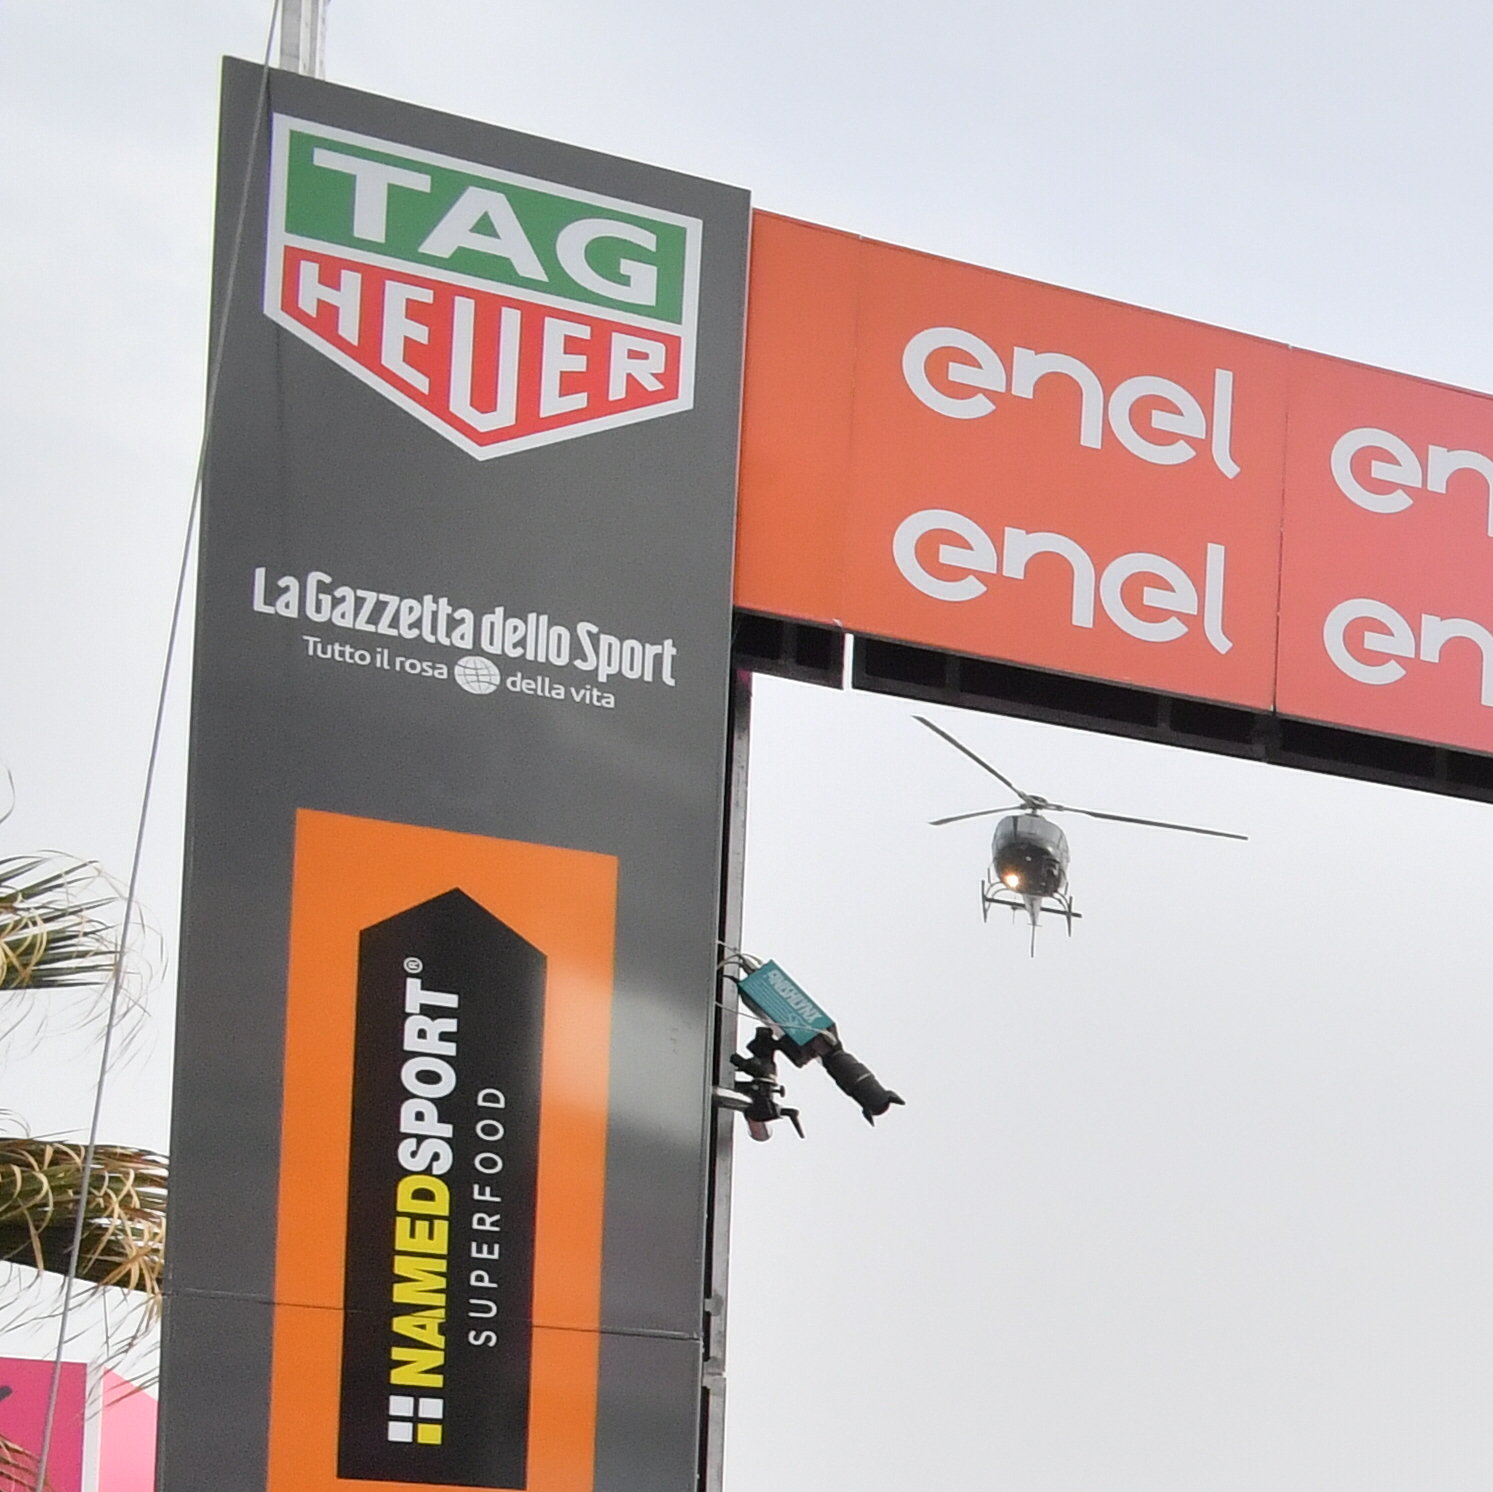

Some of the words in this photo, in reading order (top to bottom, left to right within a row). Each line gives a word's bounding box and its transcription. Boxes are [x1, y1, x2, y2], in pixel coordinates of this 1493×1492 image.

[313, 147, 658, 307] TAG
[298, 259, 665, 433] HEUER
[901, 326, 1241, 480] enel
[306, 570, 475, 650] Gazzetta
[480, 606, 569, 666] dello
[576, 621, 677, 687] Sport
[892, 508, 1234, 655] enel
[303, 636, 371, 668] Tutto
[375, 648, 392, 671] il
[394, 655, 449, 680] rosa
[506, 670, 566, 700] della
[570, 682, 616, 709] vita
[468, 1085, 508, 1347] SUPERFOOD
